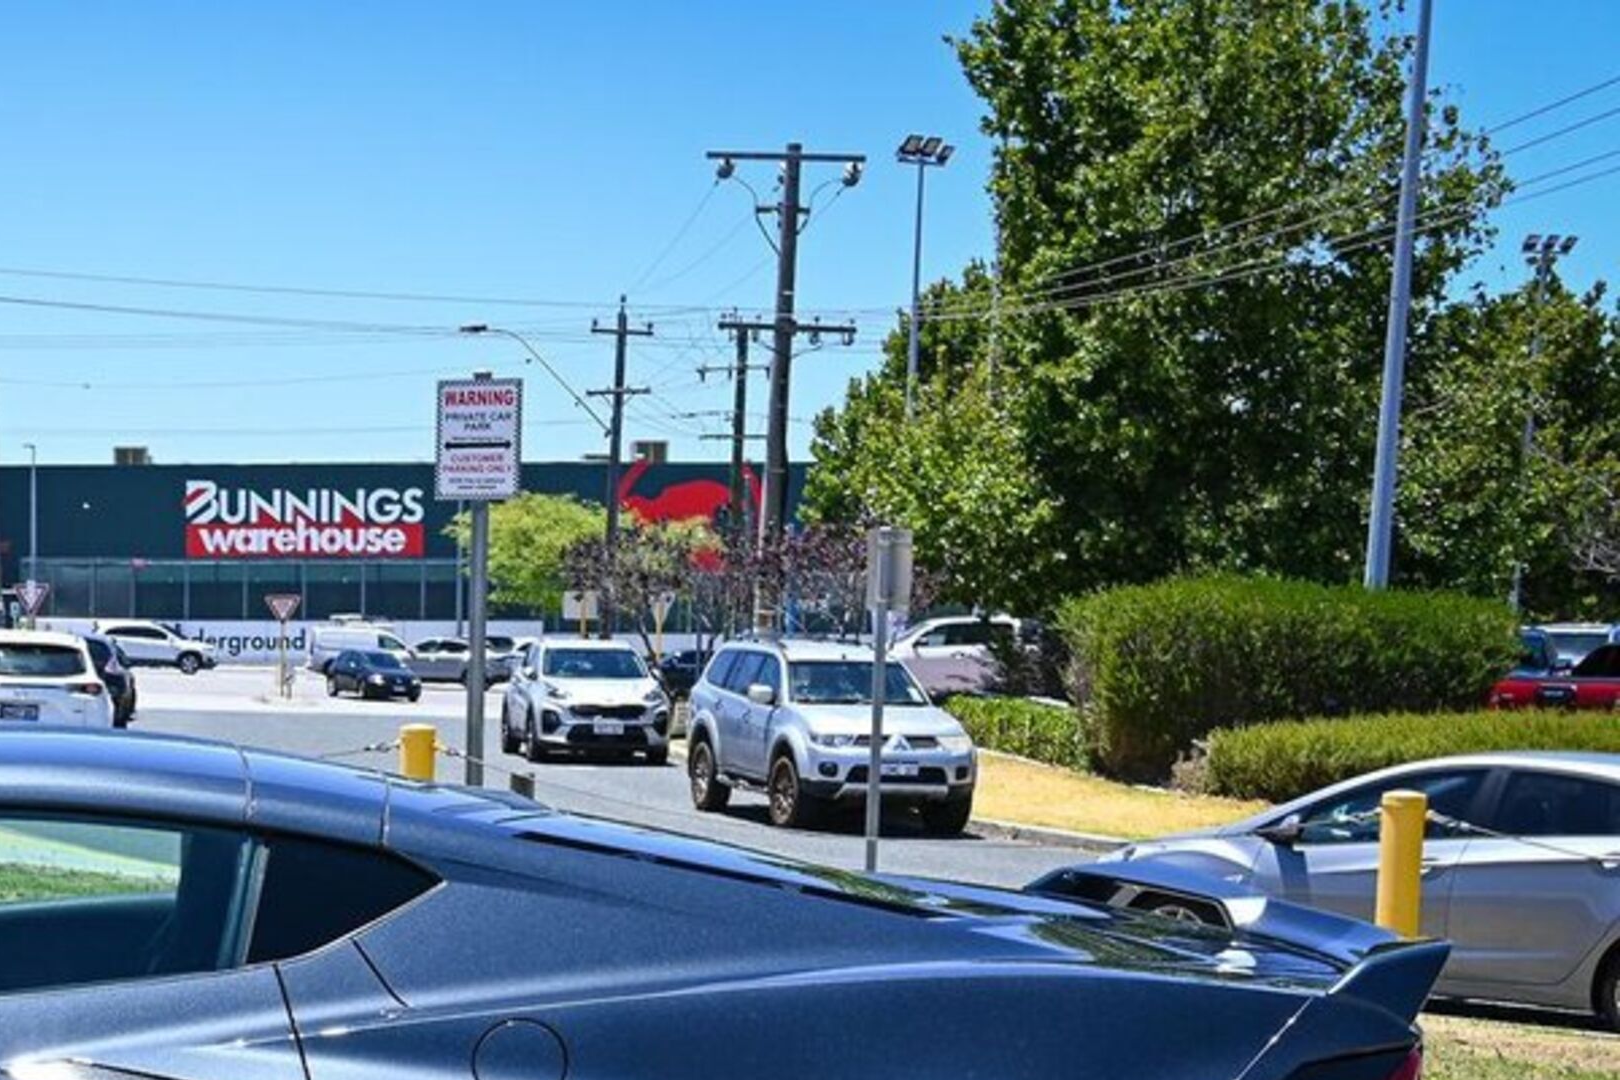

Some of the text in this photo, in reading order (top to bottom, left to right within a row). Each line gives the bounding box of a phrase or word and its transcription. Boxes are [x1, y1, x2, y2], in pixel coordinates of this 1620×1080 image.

[445, 389, 515, 406] WARNING
[445, 411, 512, 421] PRIVATE CAR
[464, 422, 491, 431] PARK
[184, 480, 424, 524] BUNNINGS
[198, 514, 407, 554] warehouse
